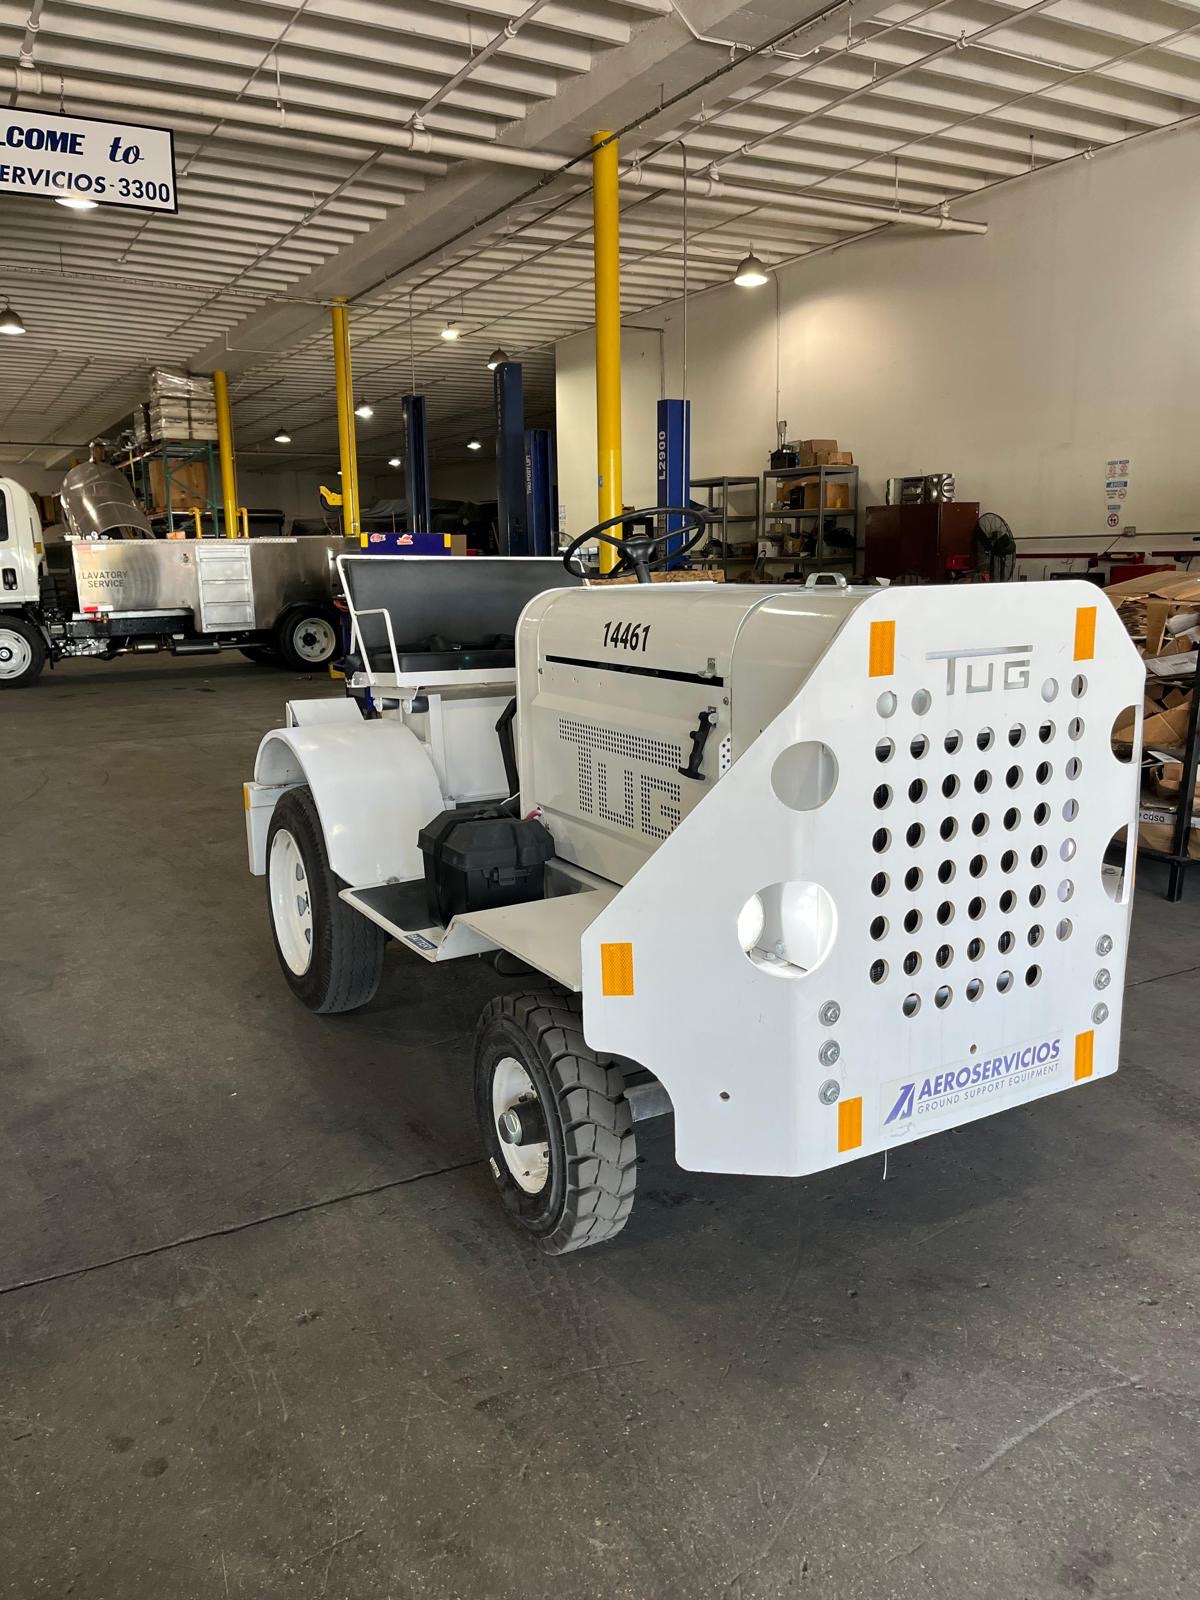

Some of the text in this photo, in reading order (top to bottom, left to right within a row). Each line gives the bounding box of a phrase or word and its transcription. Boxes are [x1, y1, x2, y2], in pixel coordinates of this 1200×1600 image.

[108, 136, 144, 164] to
[658, 430, 666, 480] L2900
[82, 570, 128, 579] LAVATORY
[88, 579, 125, 588] SERVICE
[603, 621, 651, 652] 14461
[925, 644, 1034, 696] TUG
[559, 718, 681, 840] TUG
[1142, 813, 1165, 823] casa
[917, 1063, 1060, 1115] GROUND SUPPORT EQUIPMENT
[918, 1038, 1061, 1100] AEROSERVICIOS
